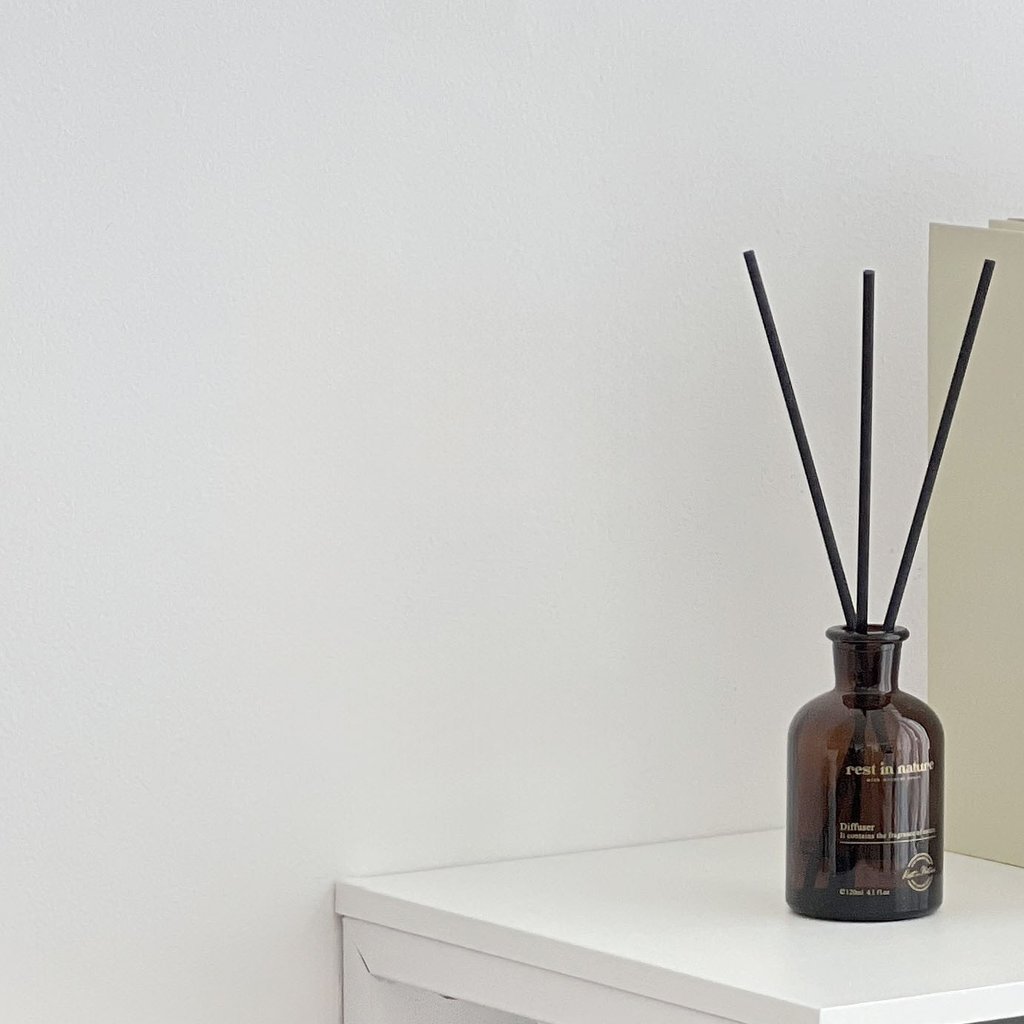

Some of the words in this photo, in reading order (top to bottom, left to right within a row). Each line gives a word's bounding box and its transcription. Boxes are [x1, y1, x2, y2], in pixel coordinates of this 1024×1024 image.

[845, 764, 876, 775] rest
[880, 761, 894, 775] in
[897, 760, 935, 774] nature
[840, 822, 875, 832] Diffuser
[847, 832, 875, 840] contains
[876, 832, 887, 840] the
